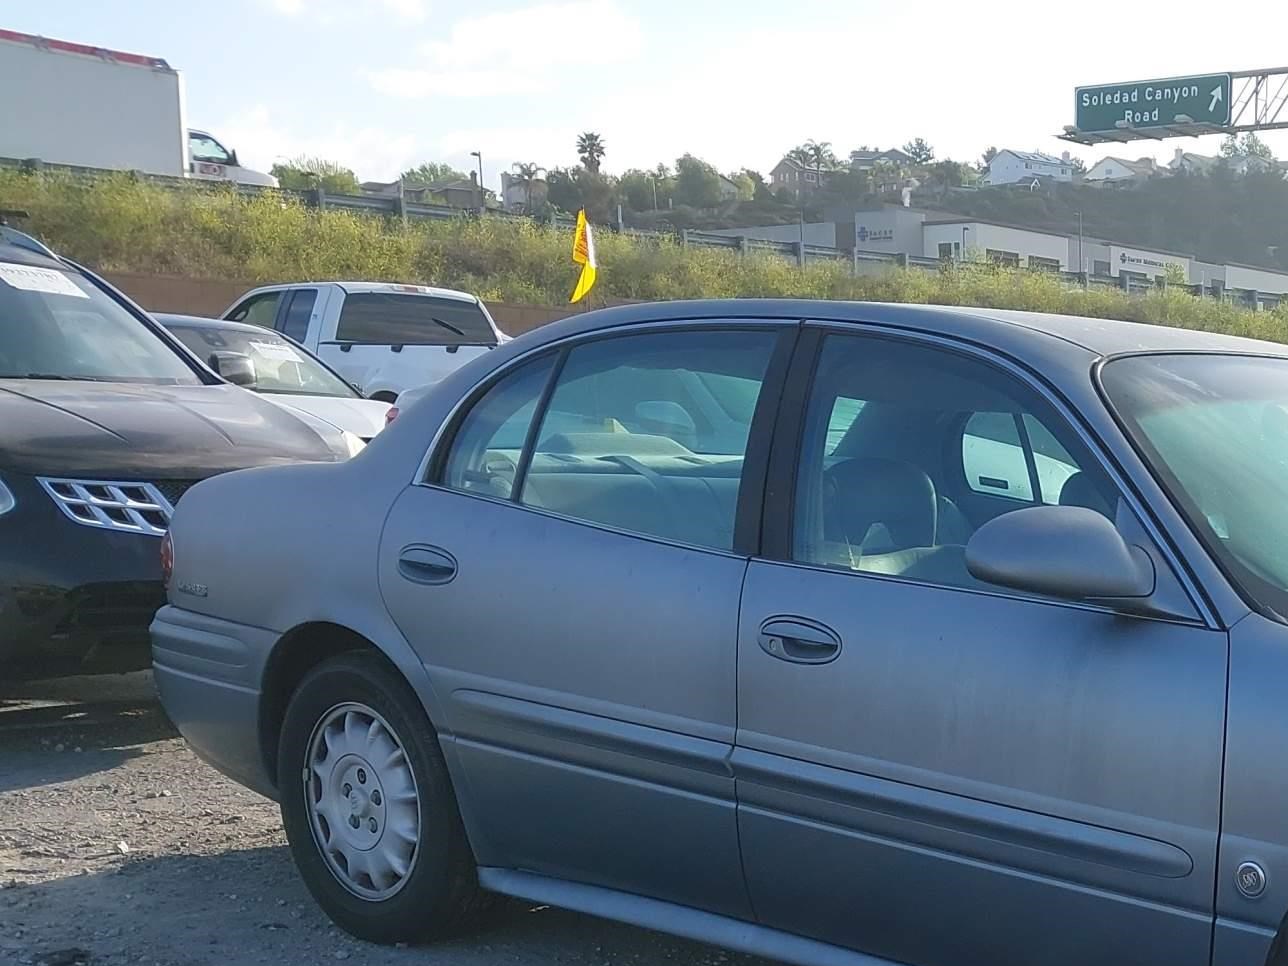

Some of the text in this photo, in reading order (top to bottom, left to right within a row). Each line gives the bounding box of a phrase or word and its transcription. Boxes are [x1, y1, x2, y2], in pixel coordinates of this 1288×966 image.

[1082, 86, 1199, 107] Soledad Canyon
[1125, 108, 1159, 123] Road
